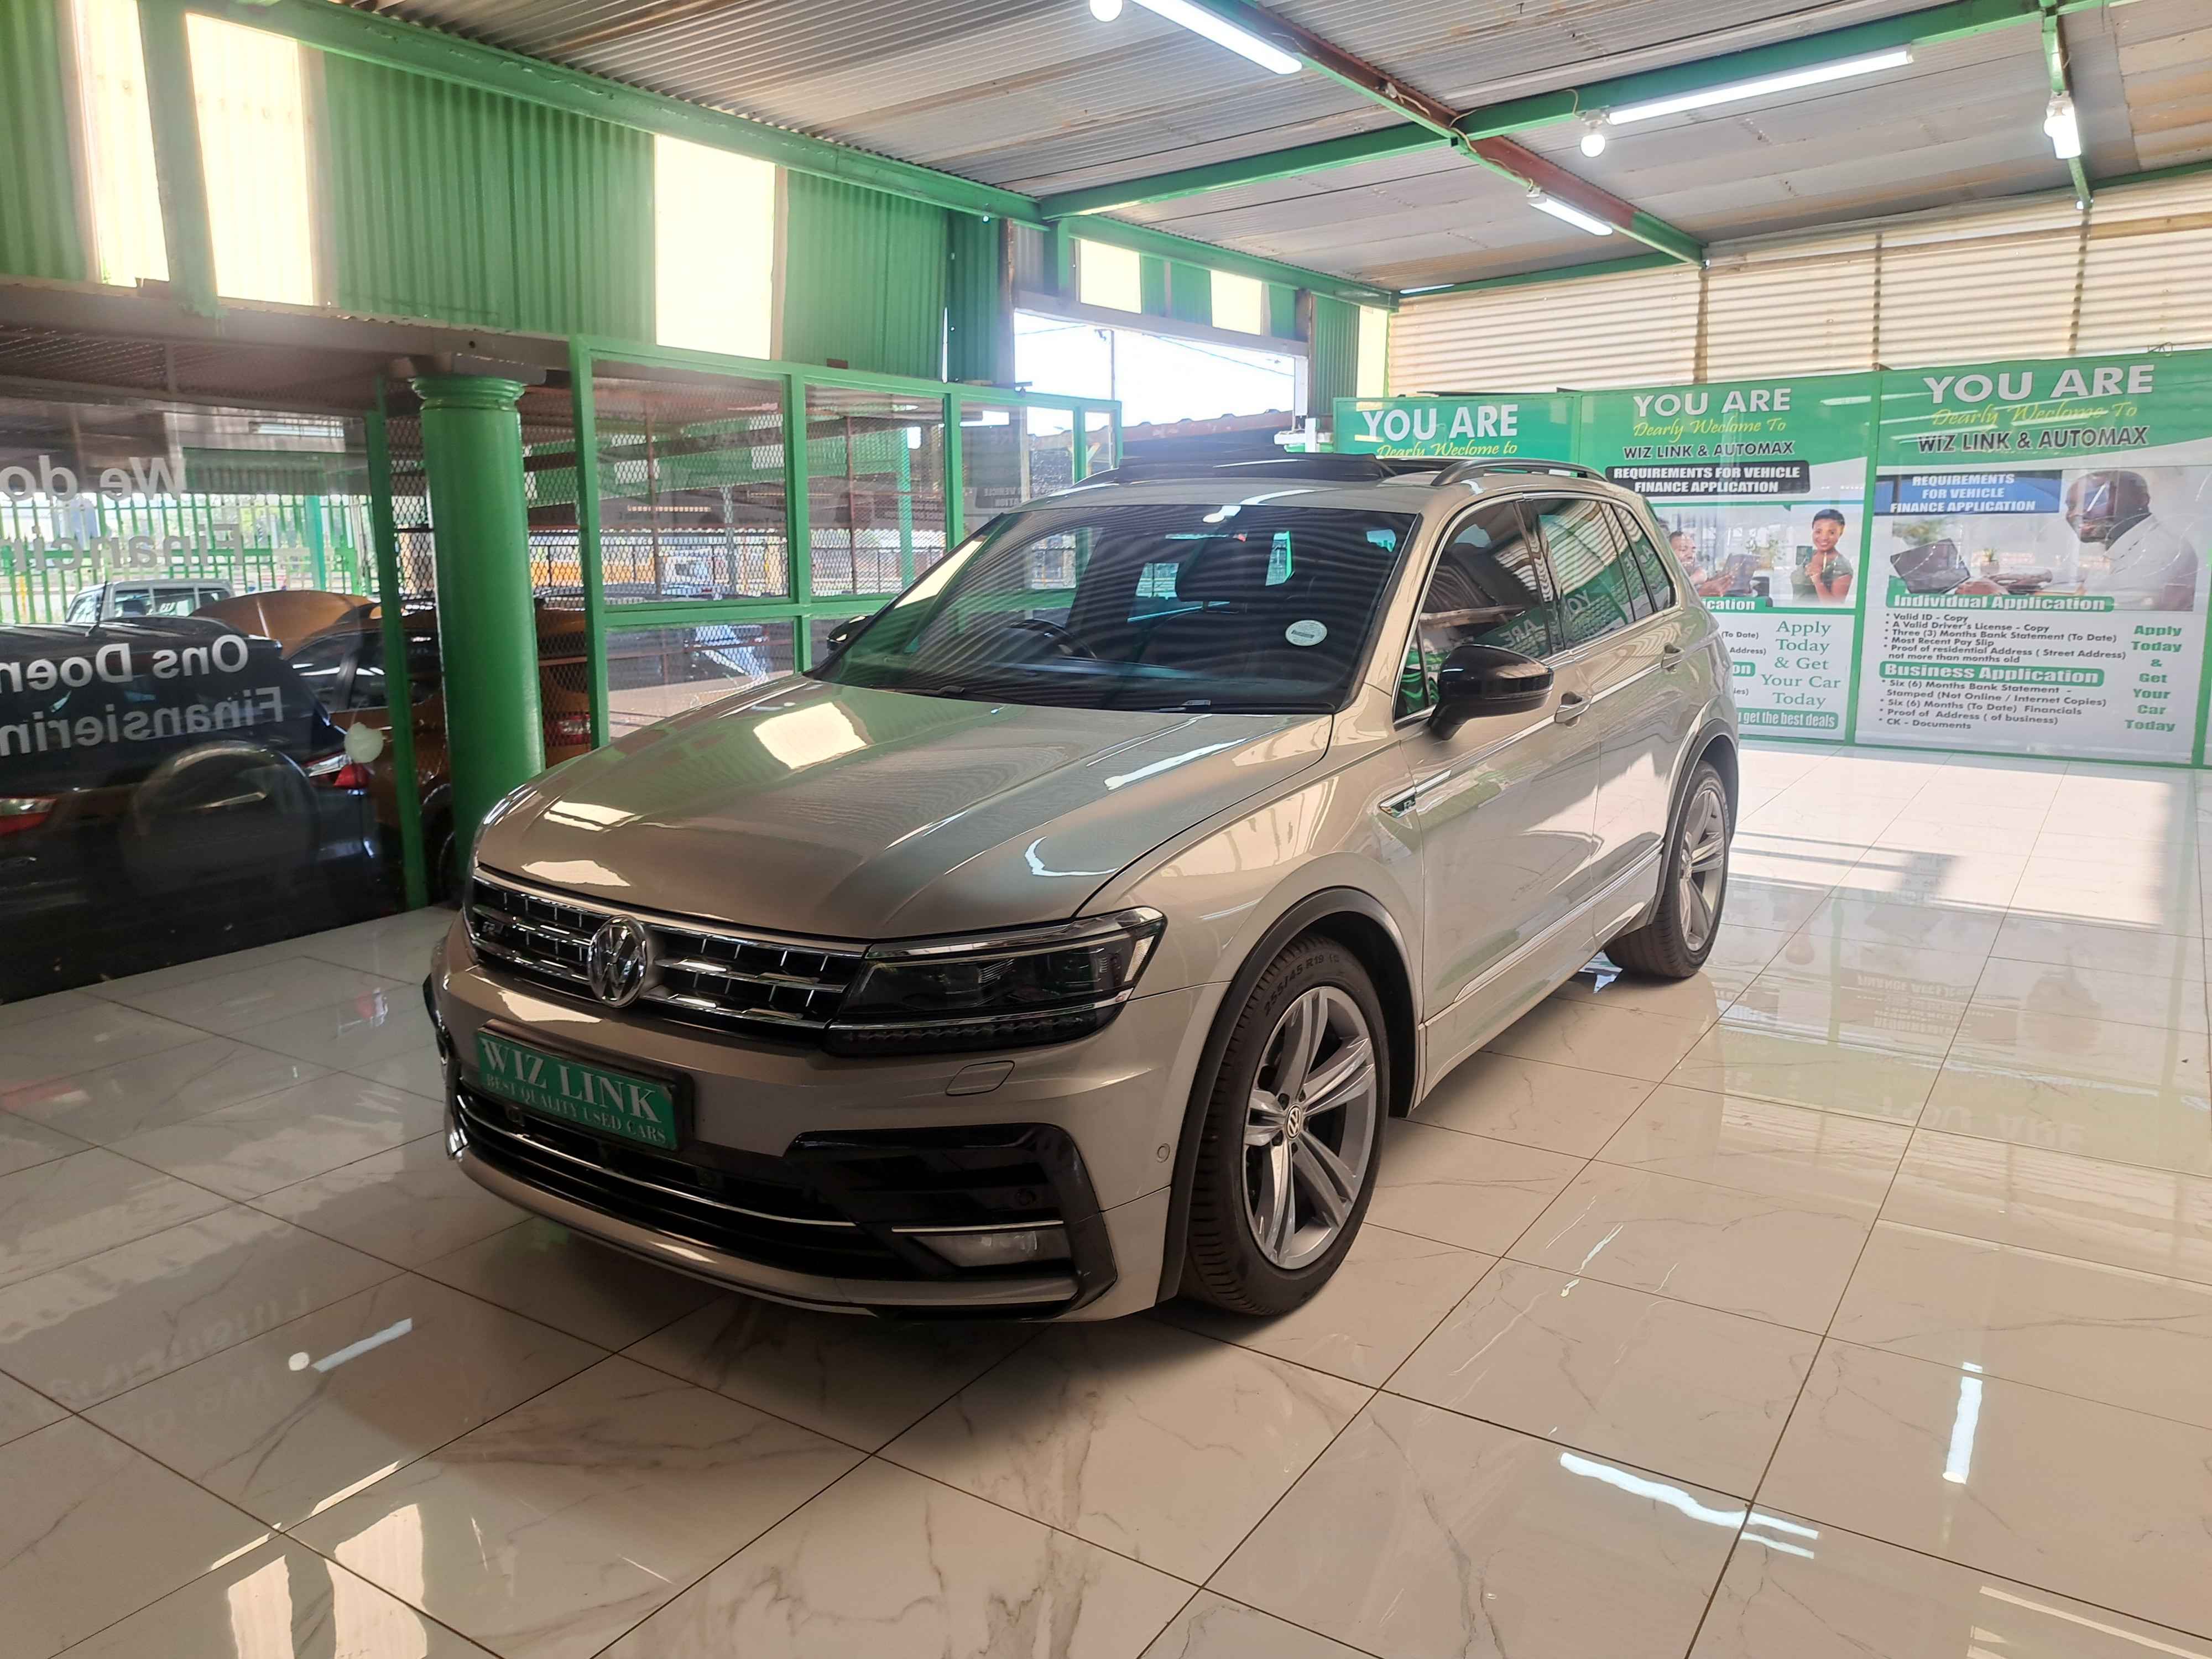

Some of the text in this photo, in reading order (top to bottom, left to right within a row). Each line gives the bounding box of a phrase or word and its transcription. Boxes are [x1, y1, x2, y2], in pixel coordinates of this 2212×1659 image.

[1923, 364, 2155, 404] YOU ARE
[1633, 388, 1791, 417] YOU ARE
[1932, 404, 1999, 425] Dearly
[2111, 401, 2137, 418] To
[1362, 404, 1518, 441] YOU ARE
[1633, 418, 1684, 442] Dearly
[1767, 418, 1786, 431] To
[1917, 426, 2150, 452] WIZ LINK & AUTOMAX
[1503, 441, 1517, 454] to
[1624, 441, 1795, 460] WIZ LINK & AUTOMAX
[1614, 467, 1801, 479] REQUIREMENTS FOR VEHICLE
[1912, 473, 2015, 486] REQUIREMENTS
[1634, 482, 1779, 493] FINANCE APPLICATION
[1922, 488, 2005, 499] FOR VEHICLE
[1890, 500, 2036, 513] FINANCE APPLICATION
[1702, 599, 1756, 611] ication
[1894, 595, 2105, 610] Individual Application
[1944, 614, 1969, 623] Copy
[1776, 620, 1832, 637] Apply
[2024, 624, 2049, 633] Copy
[2134, 625, 2182, 637] Apply
[1954, 639, 1972, 647] Pay
[1976, 639, 1994, 648] Slip
[2087, 634, 2117, 643] Date)
[1730, 647, 1766, 655] Address)
[1775, 639, 1830, 655] Today
[2131, 641, 2182, 653] Today
[2078, 650, 2126, 660] Address)
[1775, 657, 1829, 670] & Get
[2150, 659, 2162, 667] &
[1885, 663, 2099, 683] Business Application
[2139, 673, 2168, 684] Get
[1761, 674, 1841, 688] Your Car
[1908, 680, 1922, 688] (6)
[1926, 681, 1965, 690] Months
[2001, 685, 2059, 693] Statement
[1887, 689, 1934, 698] Stamped
[2014, 695, 2060, 703] Internet
[2064, 697, 2106, 707] Copies)
[2133, 688, 2171, 699] Your
[1772, 692, 1826, 709] Today
[1907, 700, 1920, 708] (6)
[1924, 701, 1964, 709] Months
[1967, 702, 1983, 711] (To
[1987, 703, 2017, 712] Date)
[2024, 706, 2082, 715] Financials
[2137, 705, 2166, 714] Car
[1744, 712, 1760, 724] get
[1762, 712, 1779, 723] the
[1781, 712, 1803, 725] best
[1806, 713, 1835, 727] deals
[1912, 719, 1971, 729] Documents
[1936, 711, 1980, 720] Address
[2005, 715, 2058, 725] business)
[2125, 719, 2176, 732] Today
[480, 1038, 662, 1123] WIZ LINK
[486, 1074, 666, 1142] BEST QUALITY USED CARS
